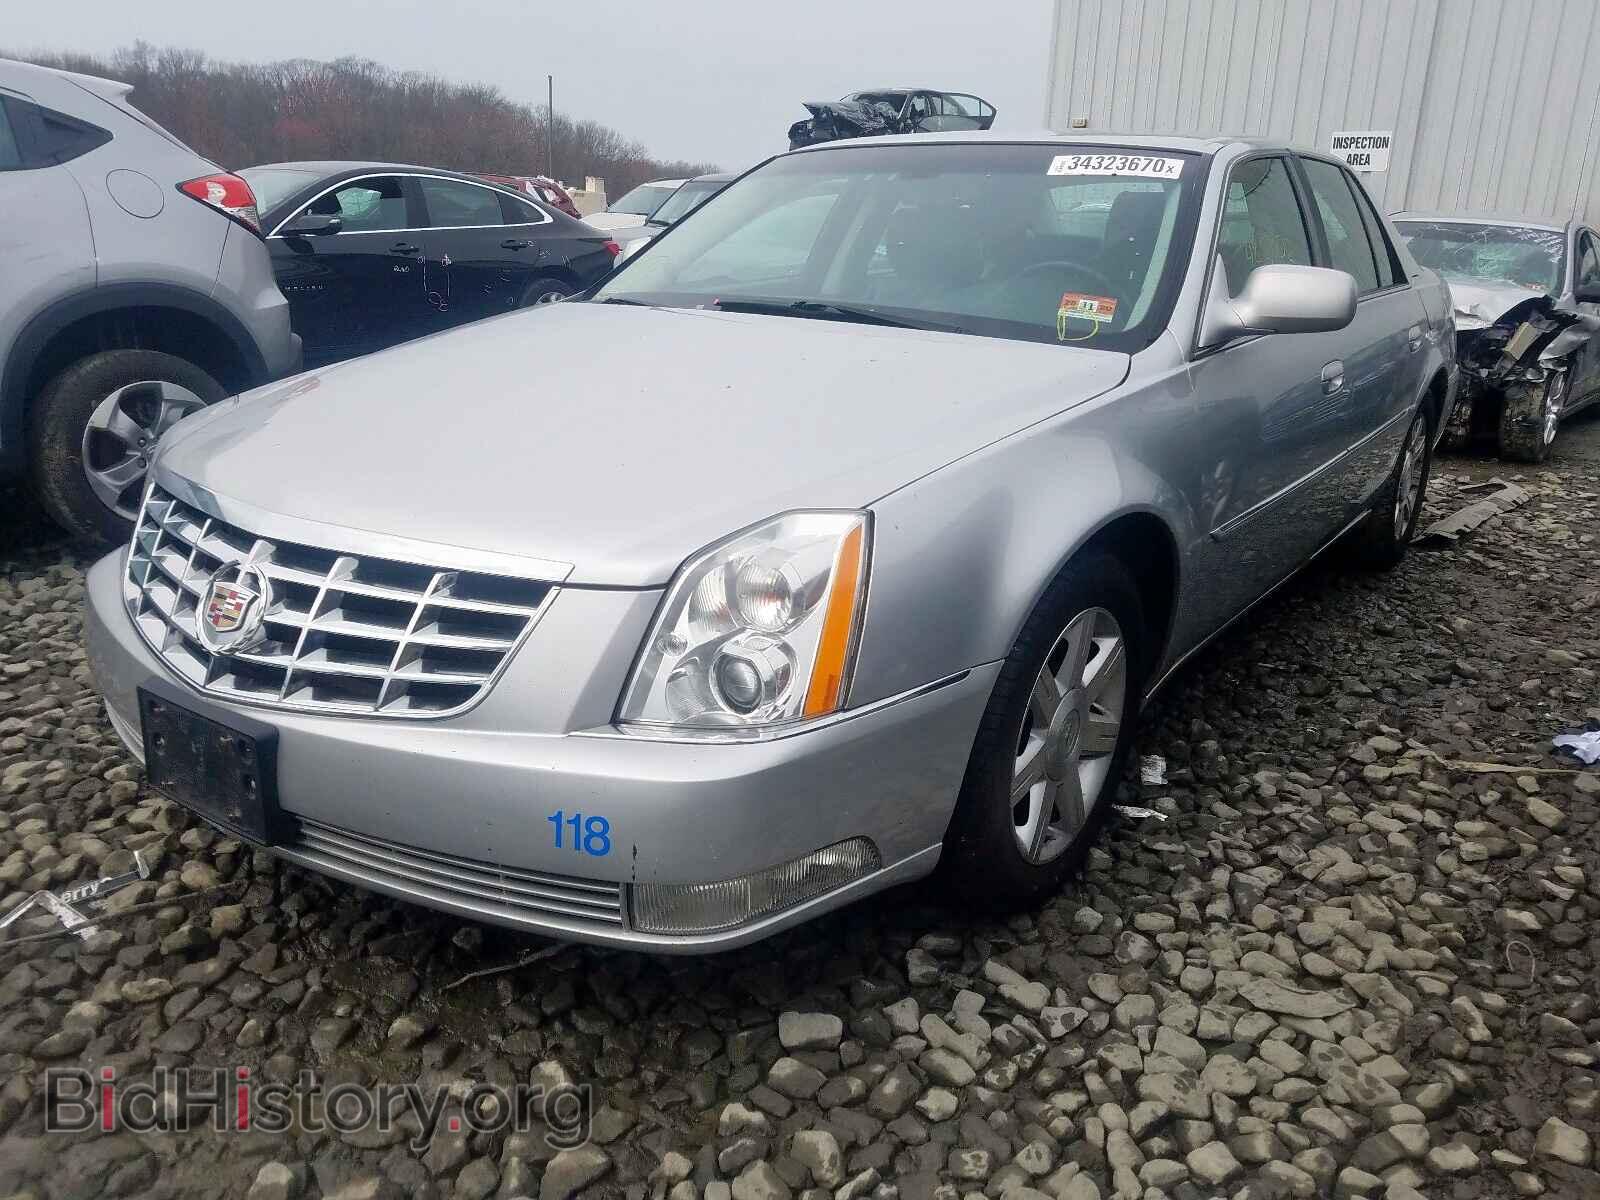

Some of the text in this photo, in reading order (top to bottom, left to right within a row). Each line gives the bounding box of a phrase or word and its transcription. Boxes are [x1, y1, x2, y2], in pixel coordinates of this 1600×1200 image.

[1332, 136, 1390, 149] INSPECTION
[1067, 155, 1166, 173] 34323670
[1346, 153, 1371, 166] AREA
[1083, 301, 1093, 311] 11
[547, 810, 611, 857] 118
